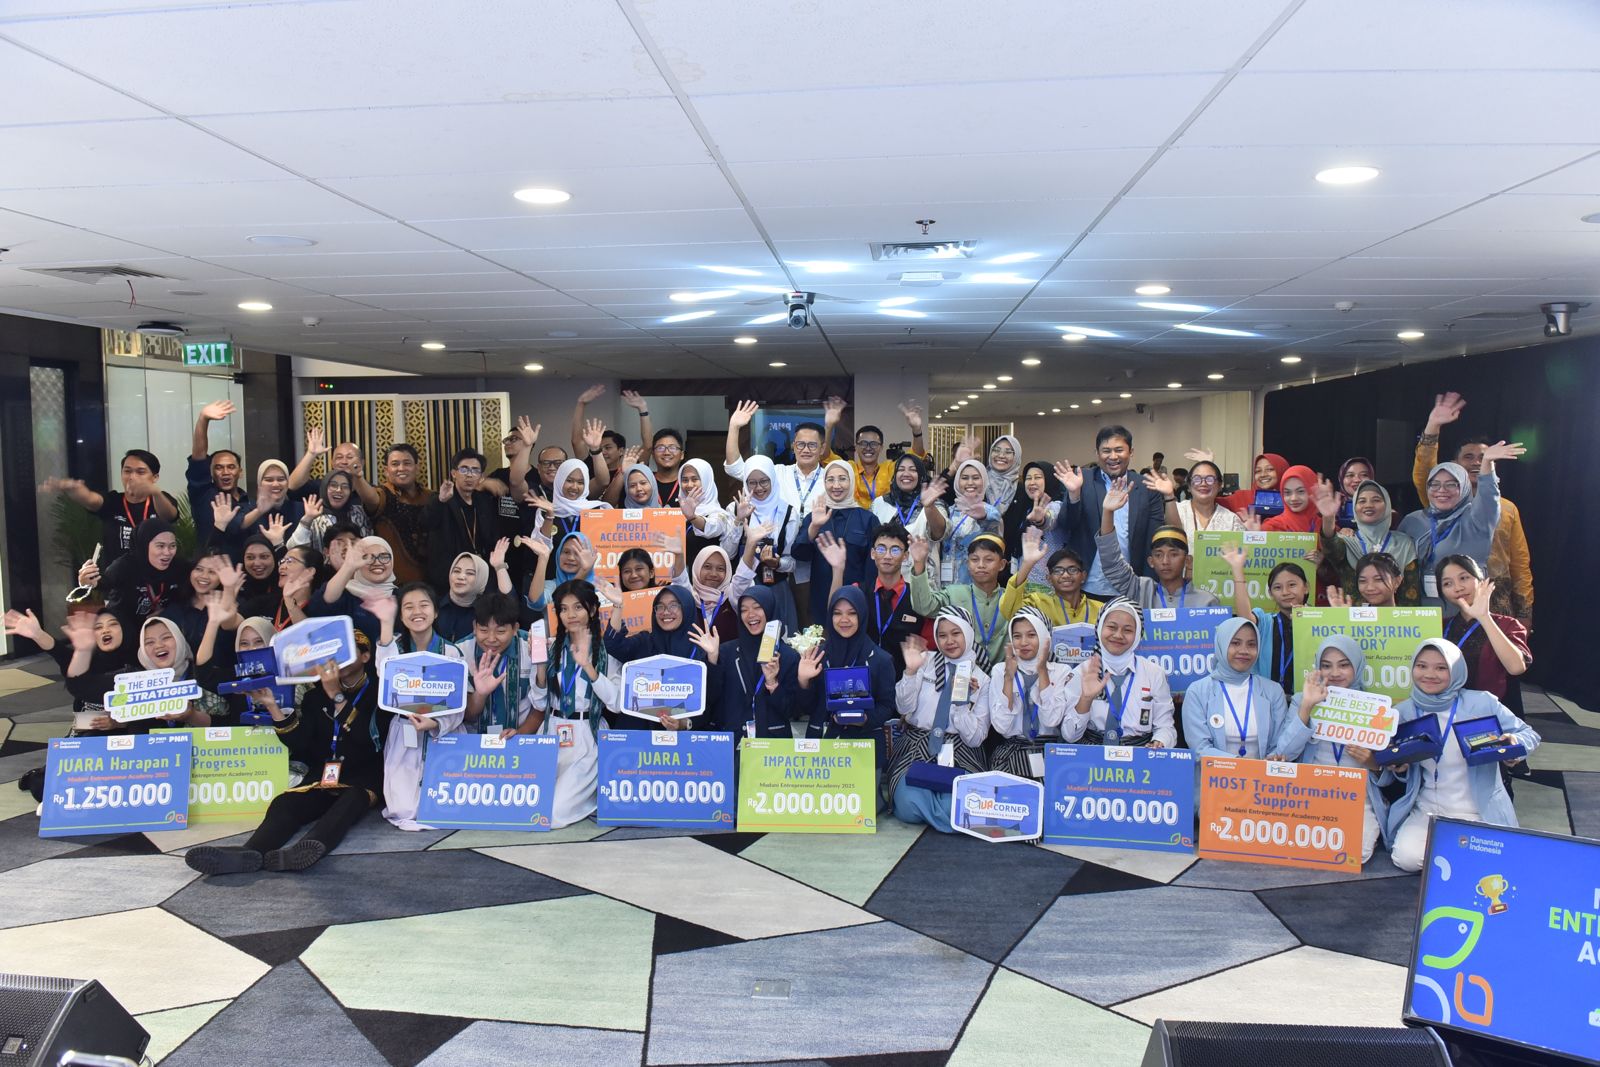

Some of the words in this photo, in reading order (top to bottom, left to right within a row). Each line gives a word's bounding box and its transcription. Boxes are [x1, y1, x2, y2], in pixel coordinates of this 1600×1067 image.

[186, 343, 228, 364] EXIT
[616, 522, 650, 531] PROFIT
[1253, 547, 1306, 558] BOOSTER
[1243, 558, 1276, 569] WARD
[1353, 609, 1375, 618] MEA
[1415, 609, 1437, 617] PNM
[1153, 628, 1209, 643] Harapan
[1312, 625, 1346, 637] MOST
[1351, 625, 1422, 638] INSPIRING
[1354, 639, 1388, 650] ORY
[128, 681, 144, 690] THE
[147, 677, 169, 688] BEST
[422, 682, 453, 690] CORNER
[127, 685, 196, 702] STRATEGIST
[1329, 696, 1347, 708] THE
[1349, 699, 1376, 712] BEST
[1314, 708, 1371, 725] ANALYST
[1316, 723, 1386, 746] 1.000.000
[192, 744, 283, 757] Documentation
[1171, 751, 1192, 760] PNM
[57, 757, 104, 776] JUARA
[110, 756, 169, 773] Harapan
[175, 754, 181, 767] I
[192, 758, 246, 771] Progress
[463, 753, 506, 771] JUARA
[511, 755, 520, 769] 3
[638, 751, 680, 768] JUARA
[686, 753, 694, 766] 1
[763, 756, 807, 767] IMPACT
[812, 756, 852, 768] MAKER
[784, 768, 831, 780] AWARD
[1088, 767, 1135, 785] JUARA
[1142, 769, 1151, 784] 2
[1270, 764, 1295, 774] MEA
[1339, 770, 1362, 779] PNM
[53, 782, 172, 810] Rp1.250.000
[188, 780, 274, 804] 000.000
[427, 781, 541, 807] Rp5.000.000
[600, 779, 726, 804] Rp10.000.000
[1209, 776, 1248, 790] MOST
[1253, 779, 1358, 801] Tranformative
[747, 791, 861, 815] Rp2.000.000
[994, 804, 1027, 813] CORNER
[1254, 793, 1309, 811] Support
[1054, 796, 1178, 825] Rp7.000.000
[1224, 806, 1247, 814] Madani
[1249, 808, 1290, 818] Entrepreneur
[1291, 811, 1321, 821] Academy
[1210, 816, 1345, 851] Rp2.000.000
[1469, 843, 1502, 855] Indonesia
[1470, 835, 1504, 848] Danantara
[1549, 906, 1600, 938] ENT
[1577, 941, 1600, 966] A
